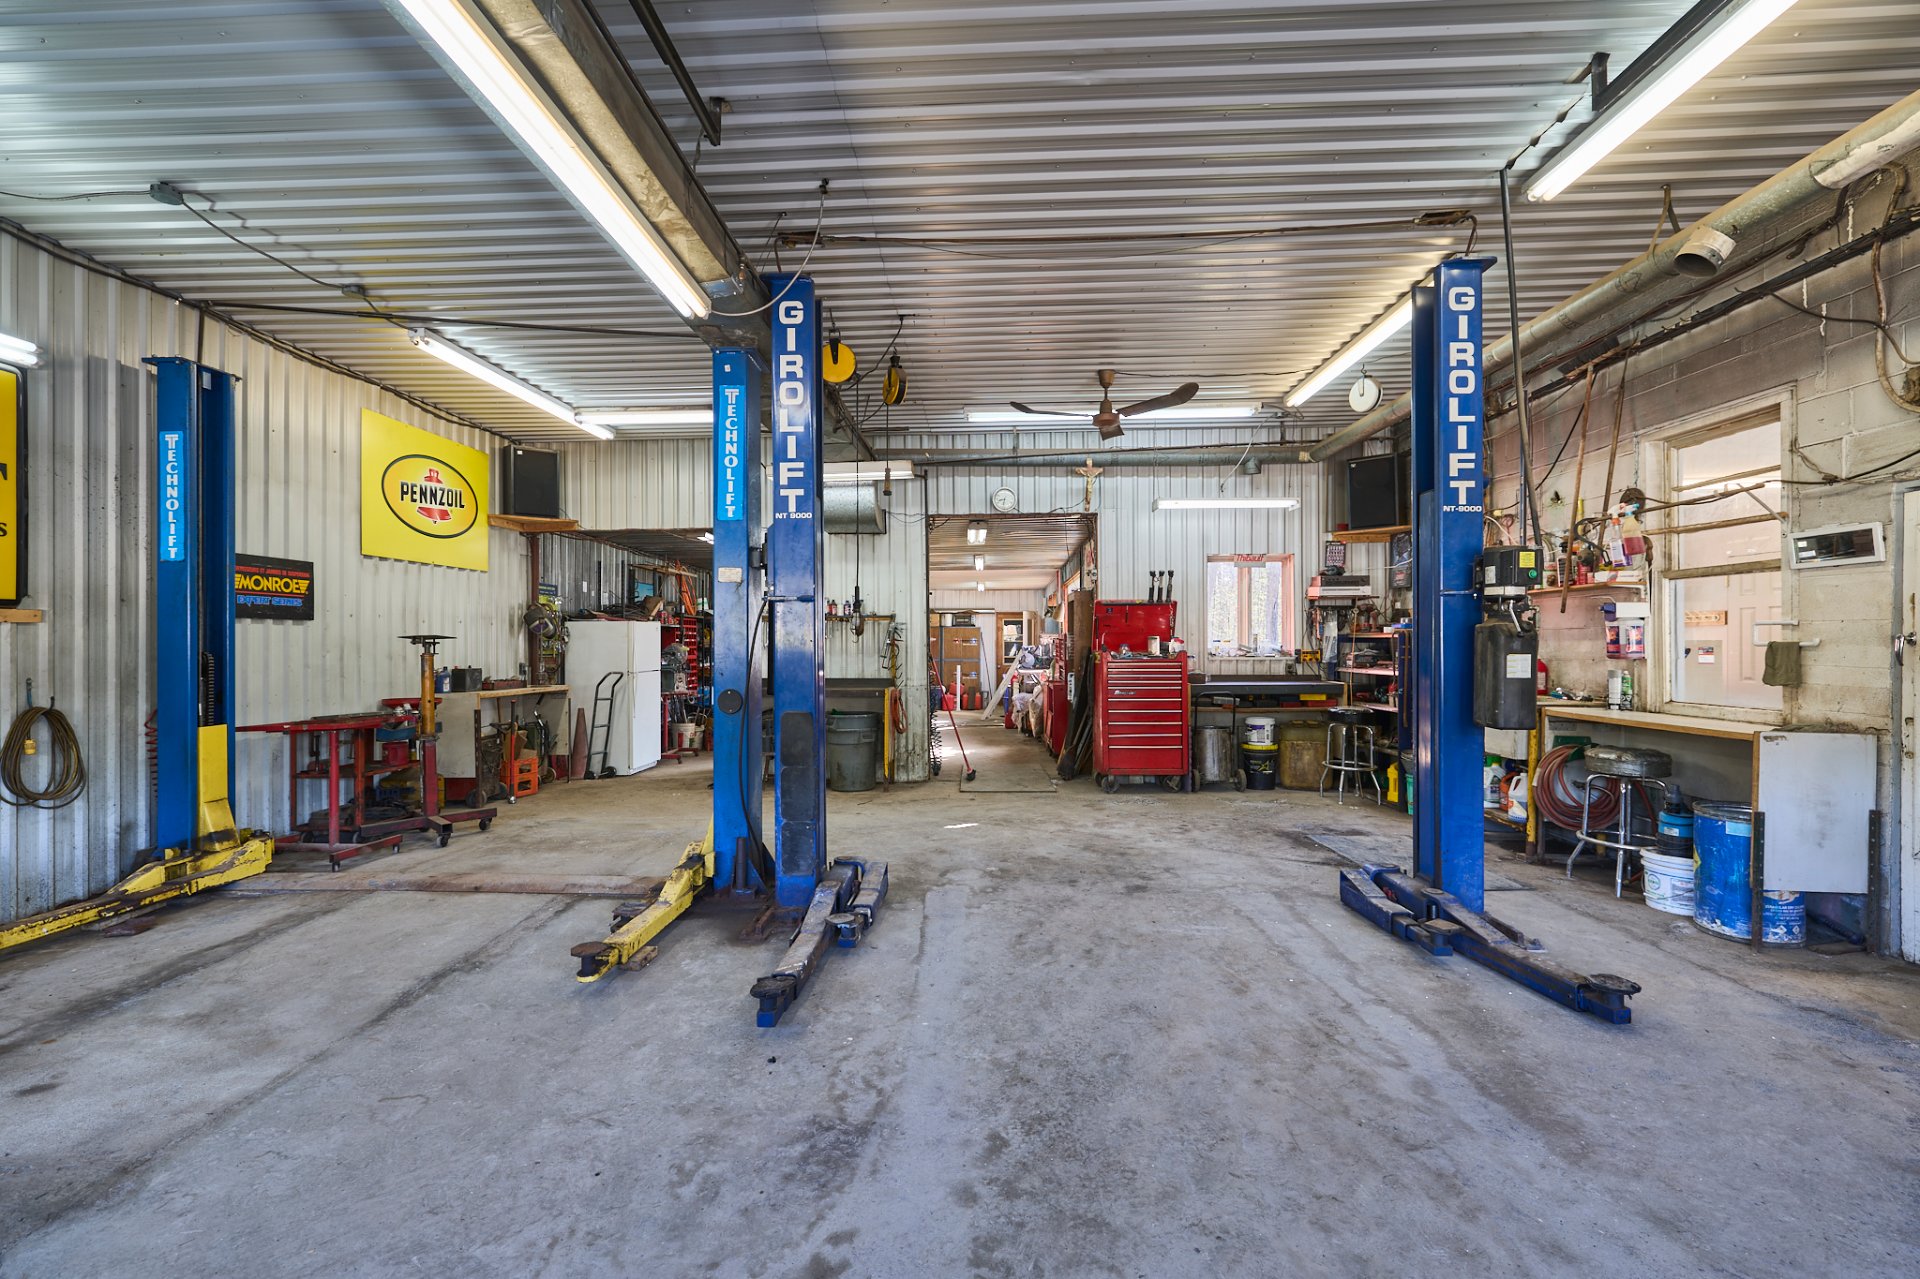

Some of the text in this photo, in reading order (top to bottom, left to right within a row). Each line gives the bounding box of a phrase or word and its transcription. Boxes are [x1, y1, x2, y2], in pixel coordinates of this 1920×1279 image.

[724, 388, 740, 518] TECHNOLIFT
[778, 300, 805, 513] GIROLIFT
[1448, 286, 1476, 505] GIROLIFT
[165, 433, 180, 559] TECHNOLIFT
[400, 481, 466, 509] PENNZOIL
[239, 573, 301, 595] MONROE
